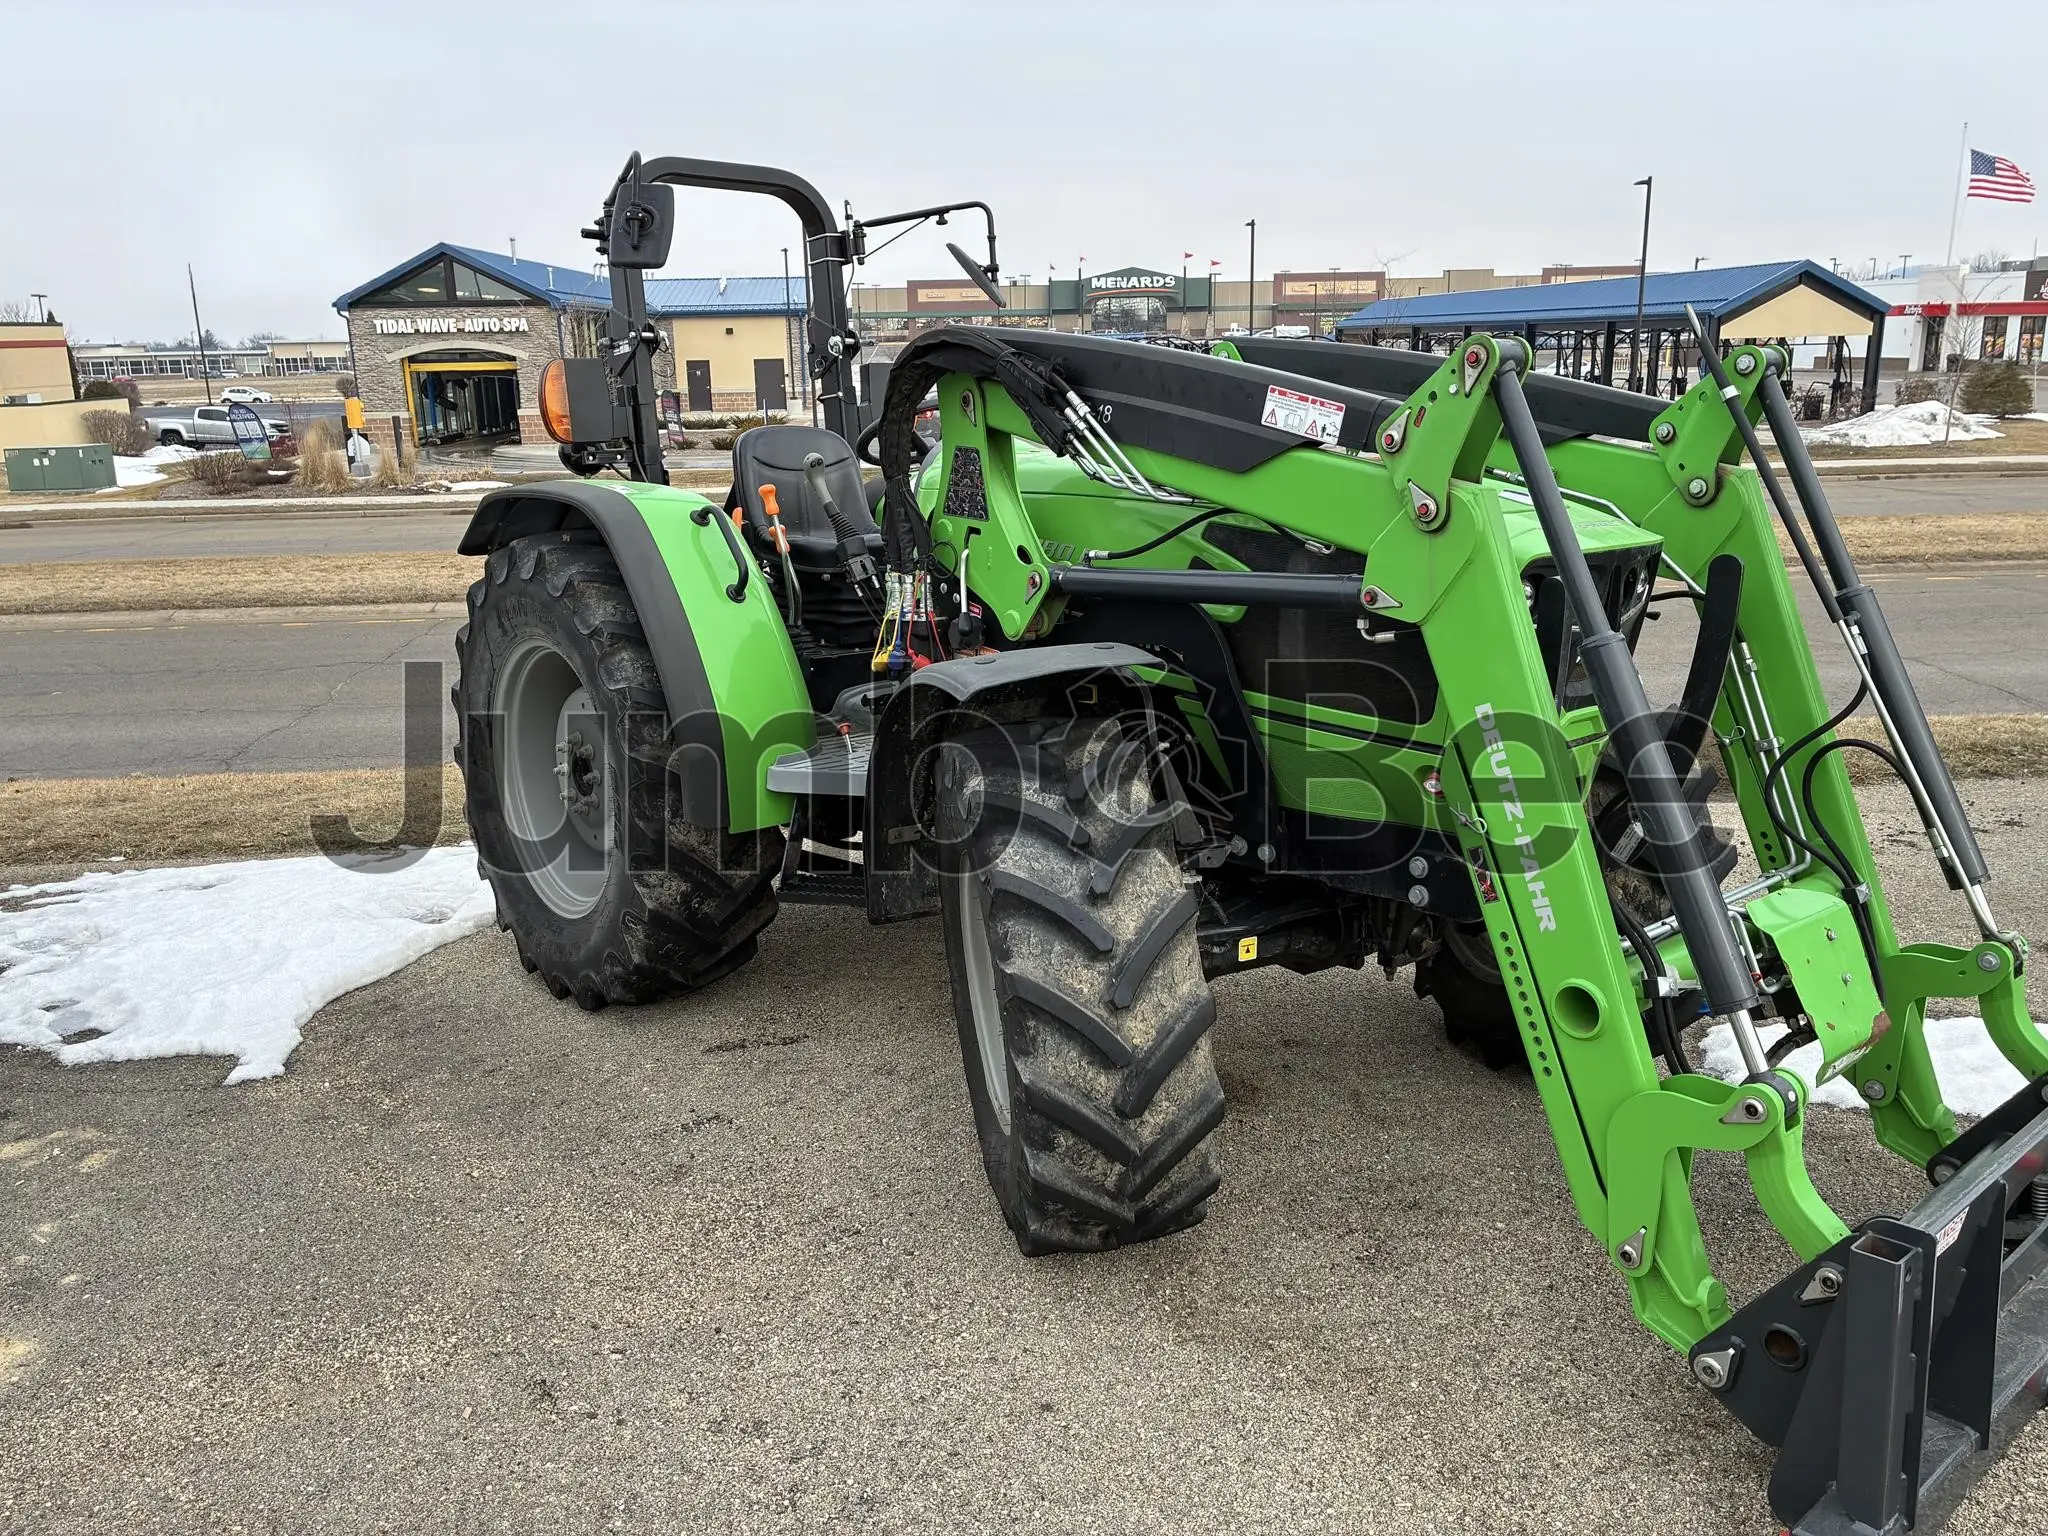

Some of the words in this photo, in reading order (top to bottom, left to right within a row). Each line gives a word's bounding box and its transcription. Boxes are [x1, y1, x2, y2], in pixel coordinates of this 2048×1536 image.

[1091, 276, 1176, 289] MENARDS
[373, 319, 415, 334] TIDAL
[417, 319, 458, 333] WAVE
[464, 318, 501, 332] AUTO
[502, 317, 529, 332] SPA
[1474, 702, 1557, 934] DEUTZ-FAHR
